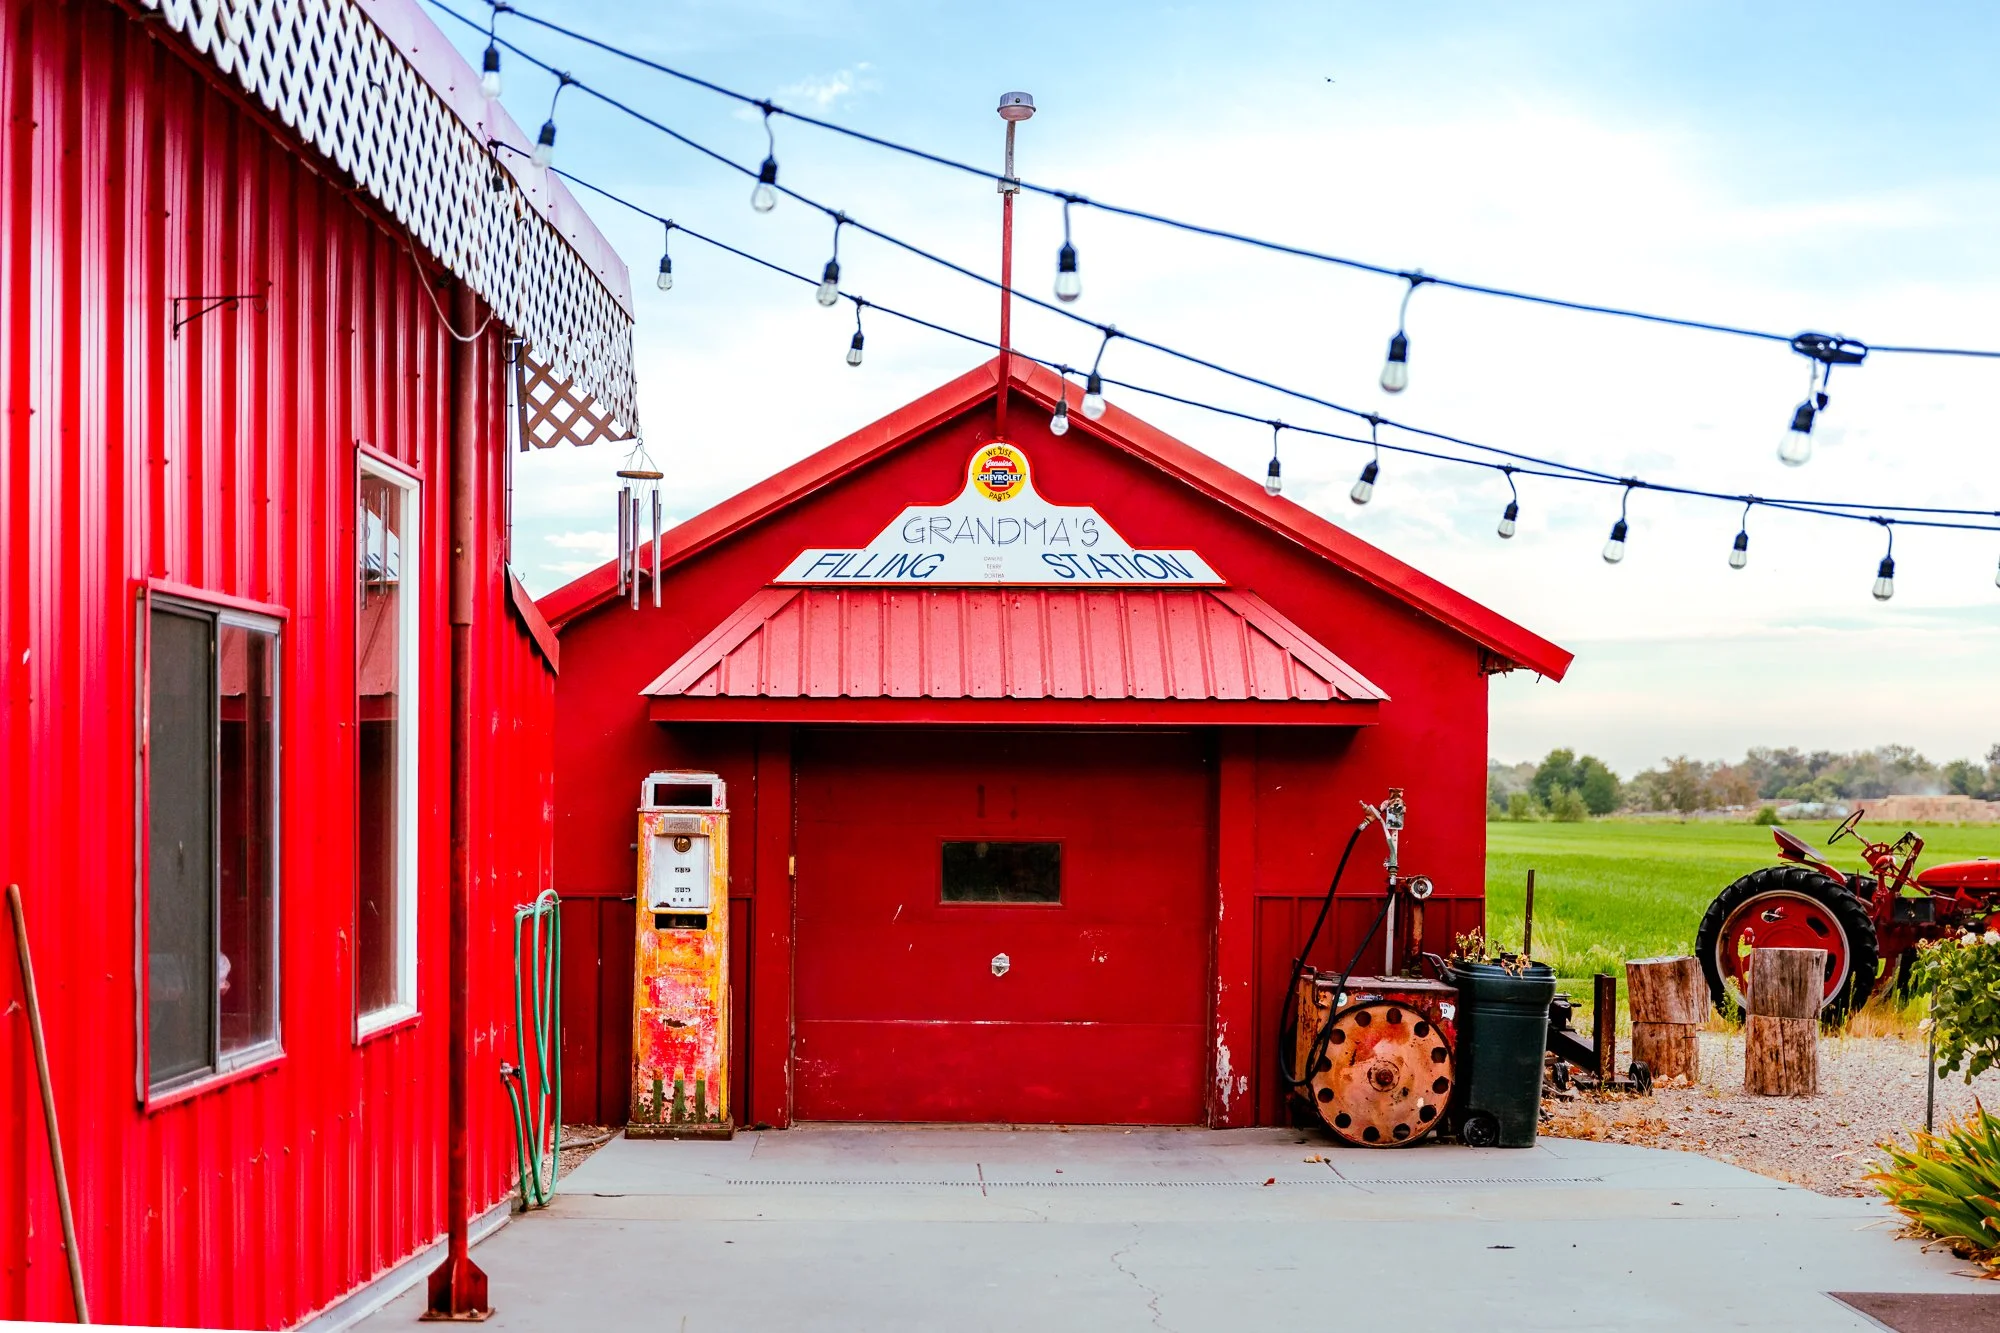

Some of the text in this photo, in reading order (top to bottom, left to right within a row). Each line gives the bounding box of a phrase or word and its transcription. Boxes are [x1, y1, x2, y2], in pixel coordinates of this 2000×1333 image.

[985, 448, 996, 457] WE
[988, 492, 1011, 500] PARTS
[902, 516, 1100, 547] GRANDMA'S
[802, 553, 1194, 579] FILLING STATION
